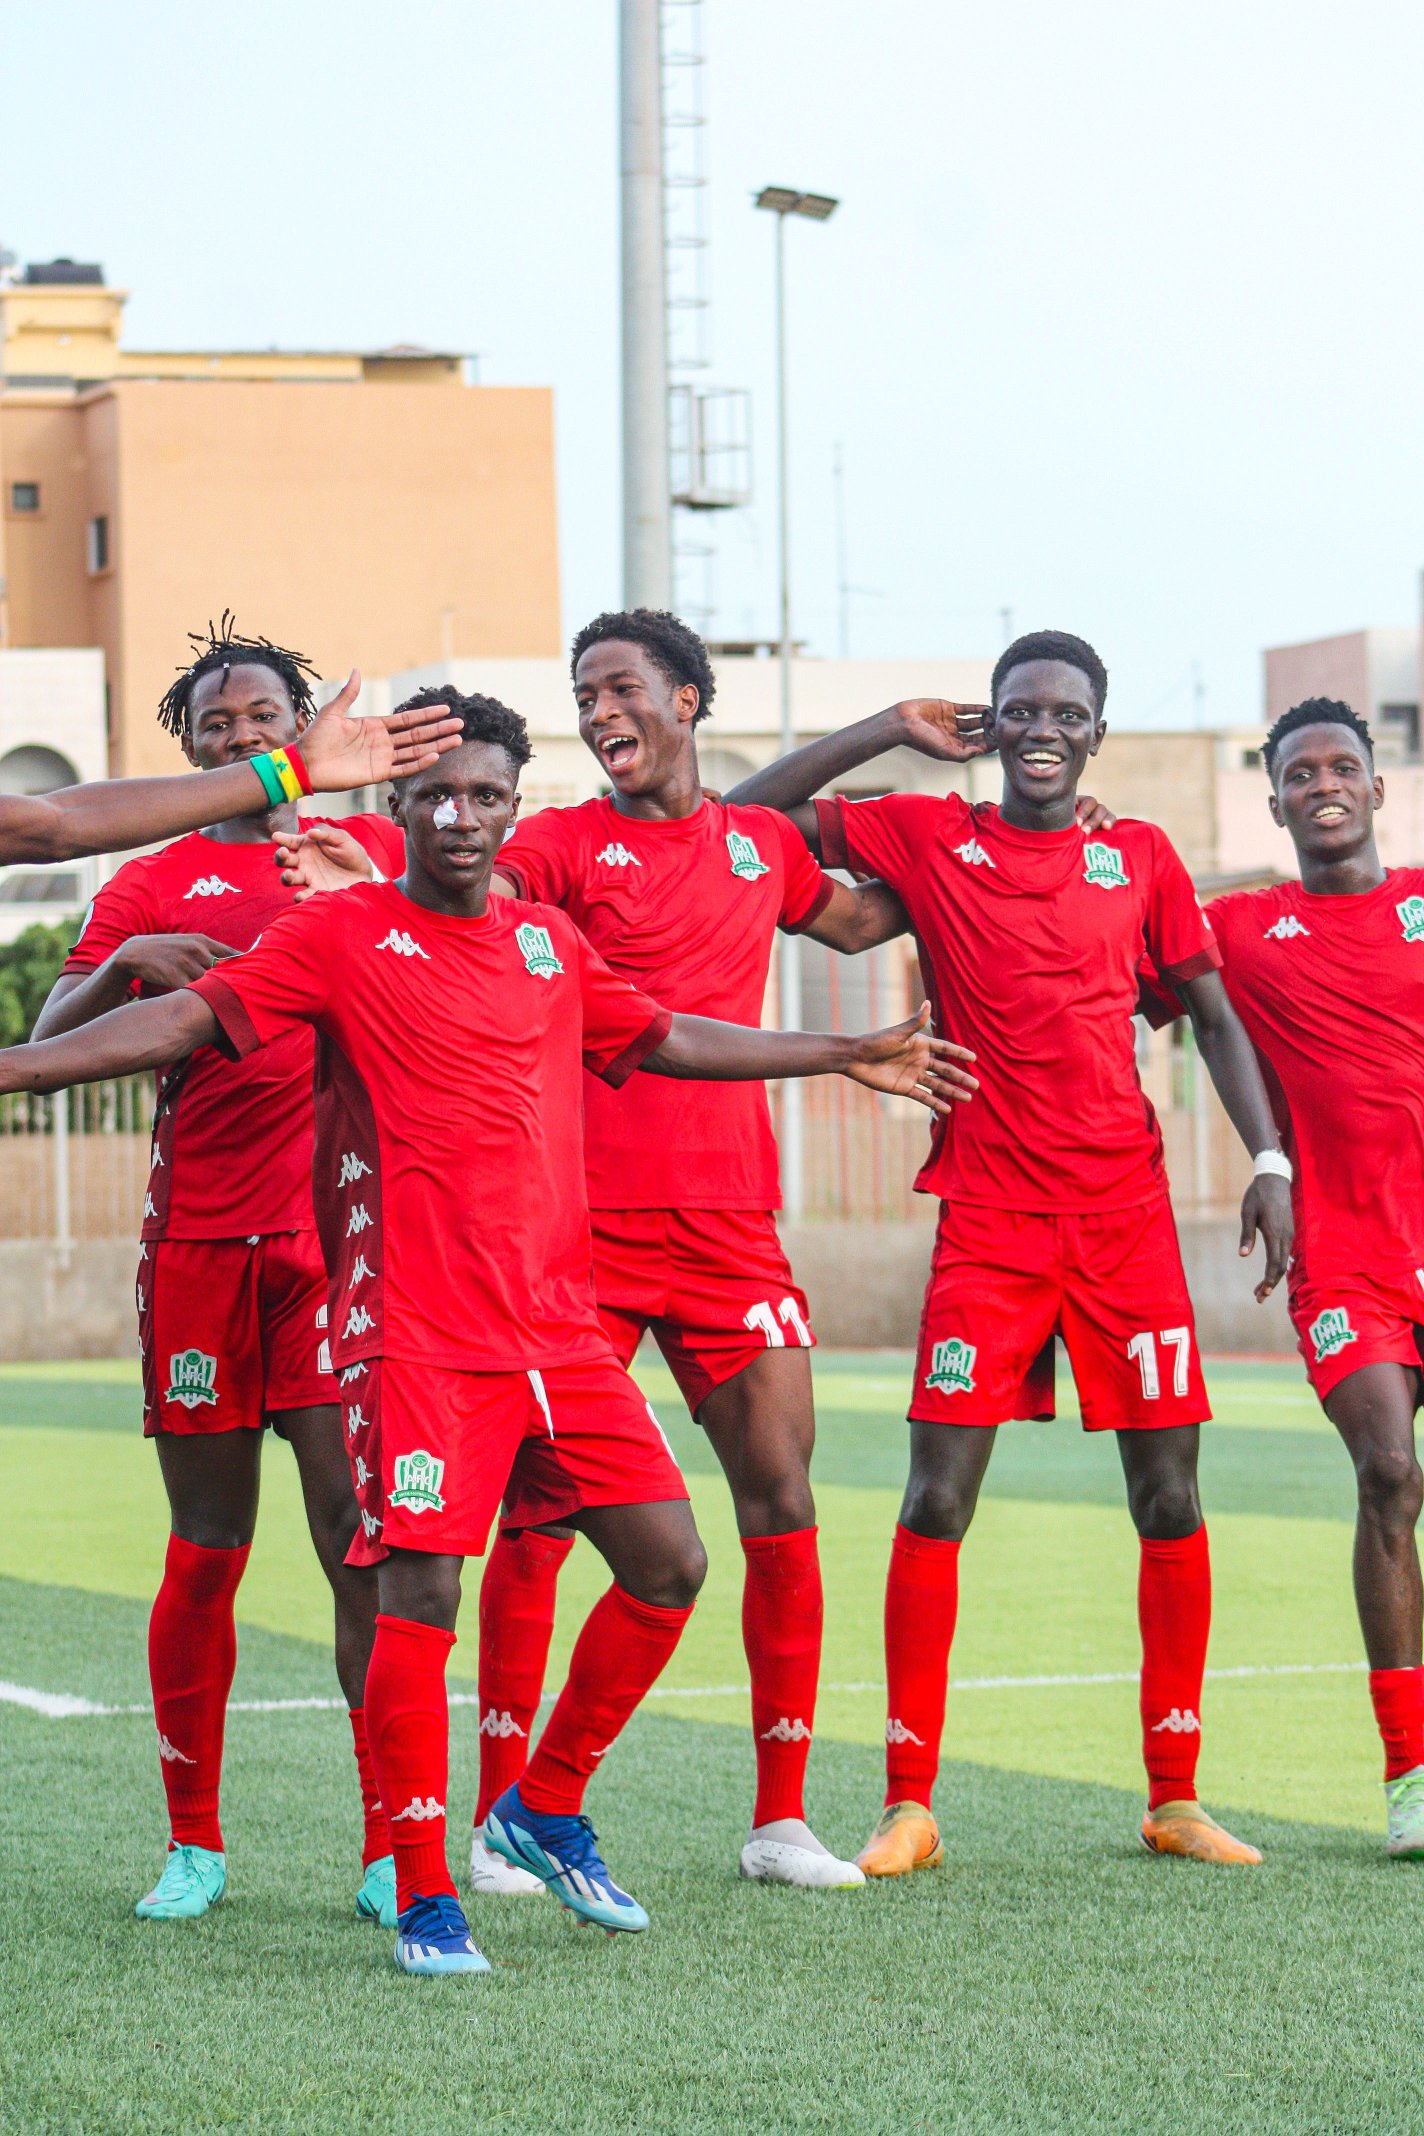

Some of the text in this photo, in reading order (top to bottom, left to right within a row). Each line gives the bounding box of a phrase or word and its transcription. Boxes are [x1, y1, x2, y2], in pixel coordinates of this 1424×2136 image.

[743, 1297, 812, 1347] 11
[1127, 1326, 1190, 1399] 17
[406, 1474, 432, 1485] AFC
